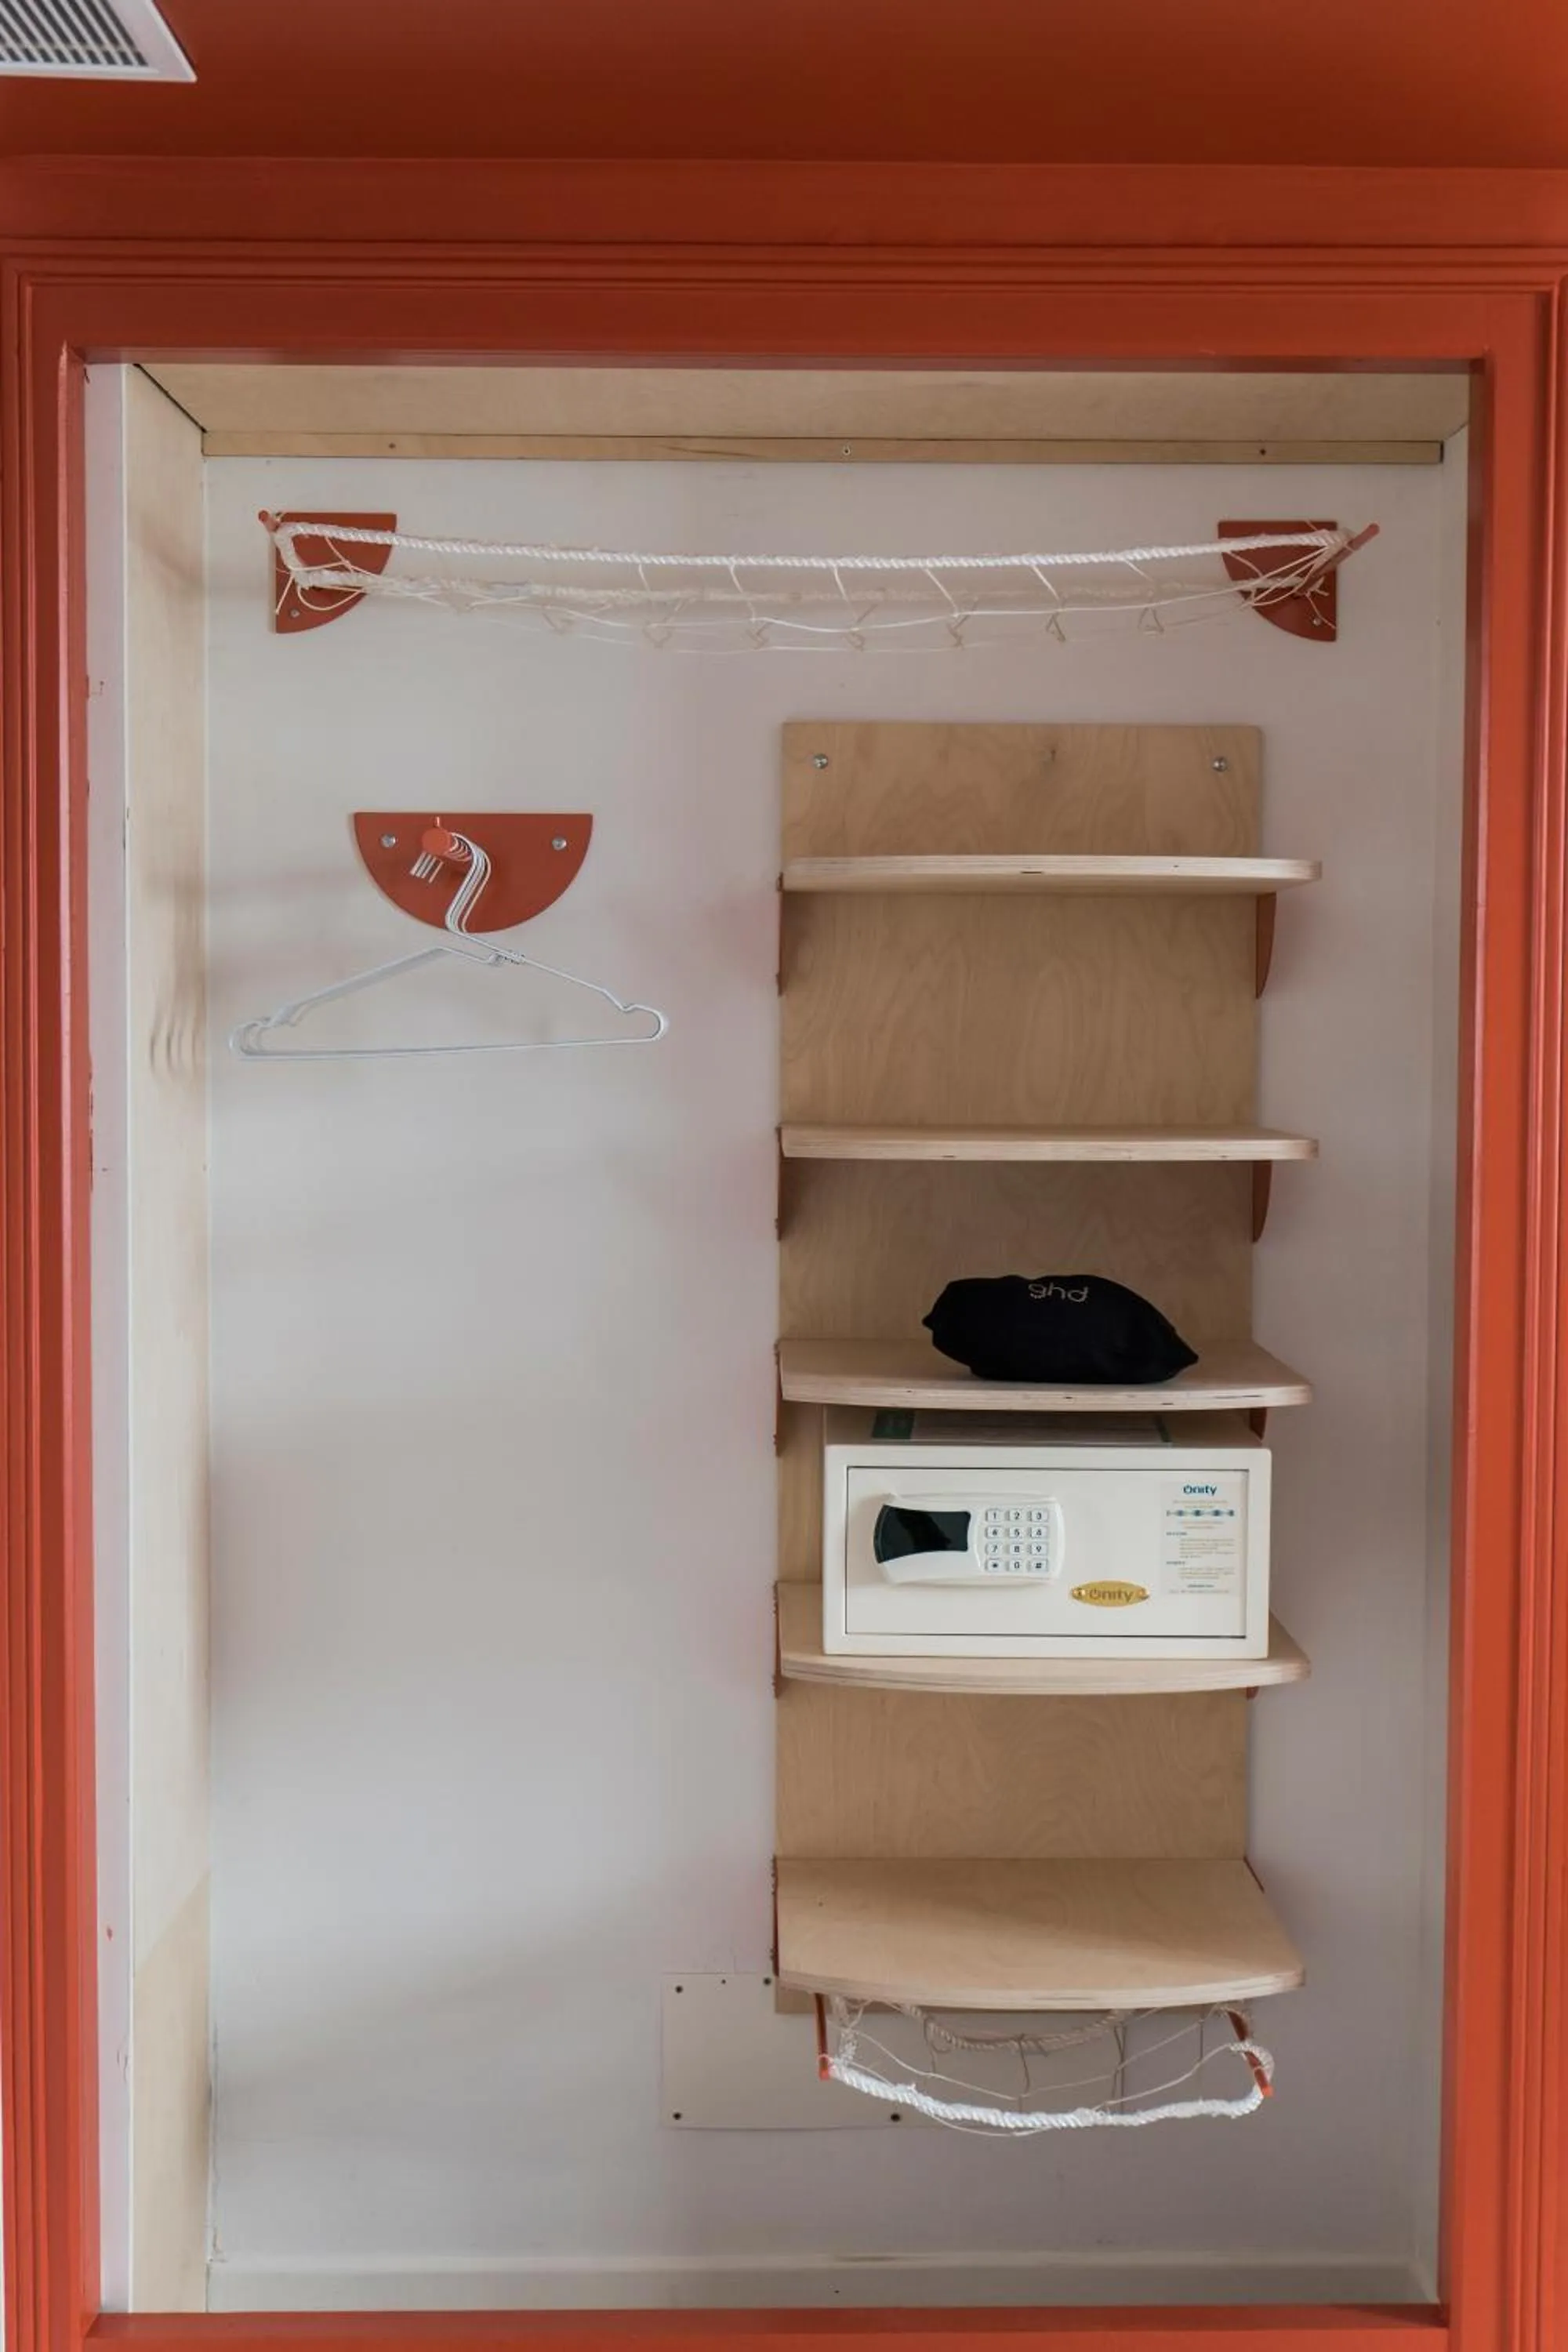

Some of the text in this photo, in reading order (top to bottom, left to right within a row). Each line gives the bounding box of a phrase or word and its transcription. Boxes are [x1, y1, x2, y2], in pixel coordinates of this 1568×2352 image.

[1028, 1282, 1088, 1302] ghd
[1014, 1511, 1020, 1520] 2
[1036, 1512, 1042, 1520] 3
[1014, 1528, 1020, 1537] 5
[992, 1544, 998, 1553] 7
[1089, 1588, 1134, 1602] Onity
